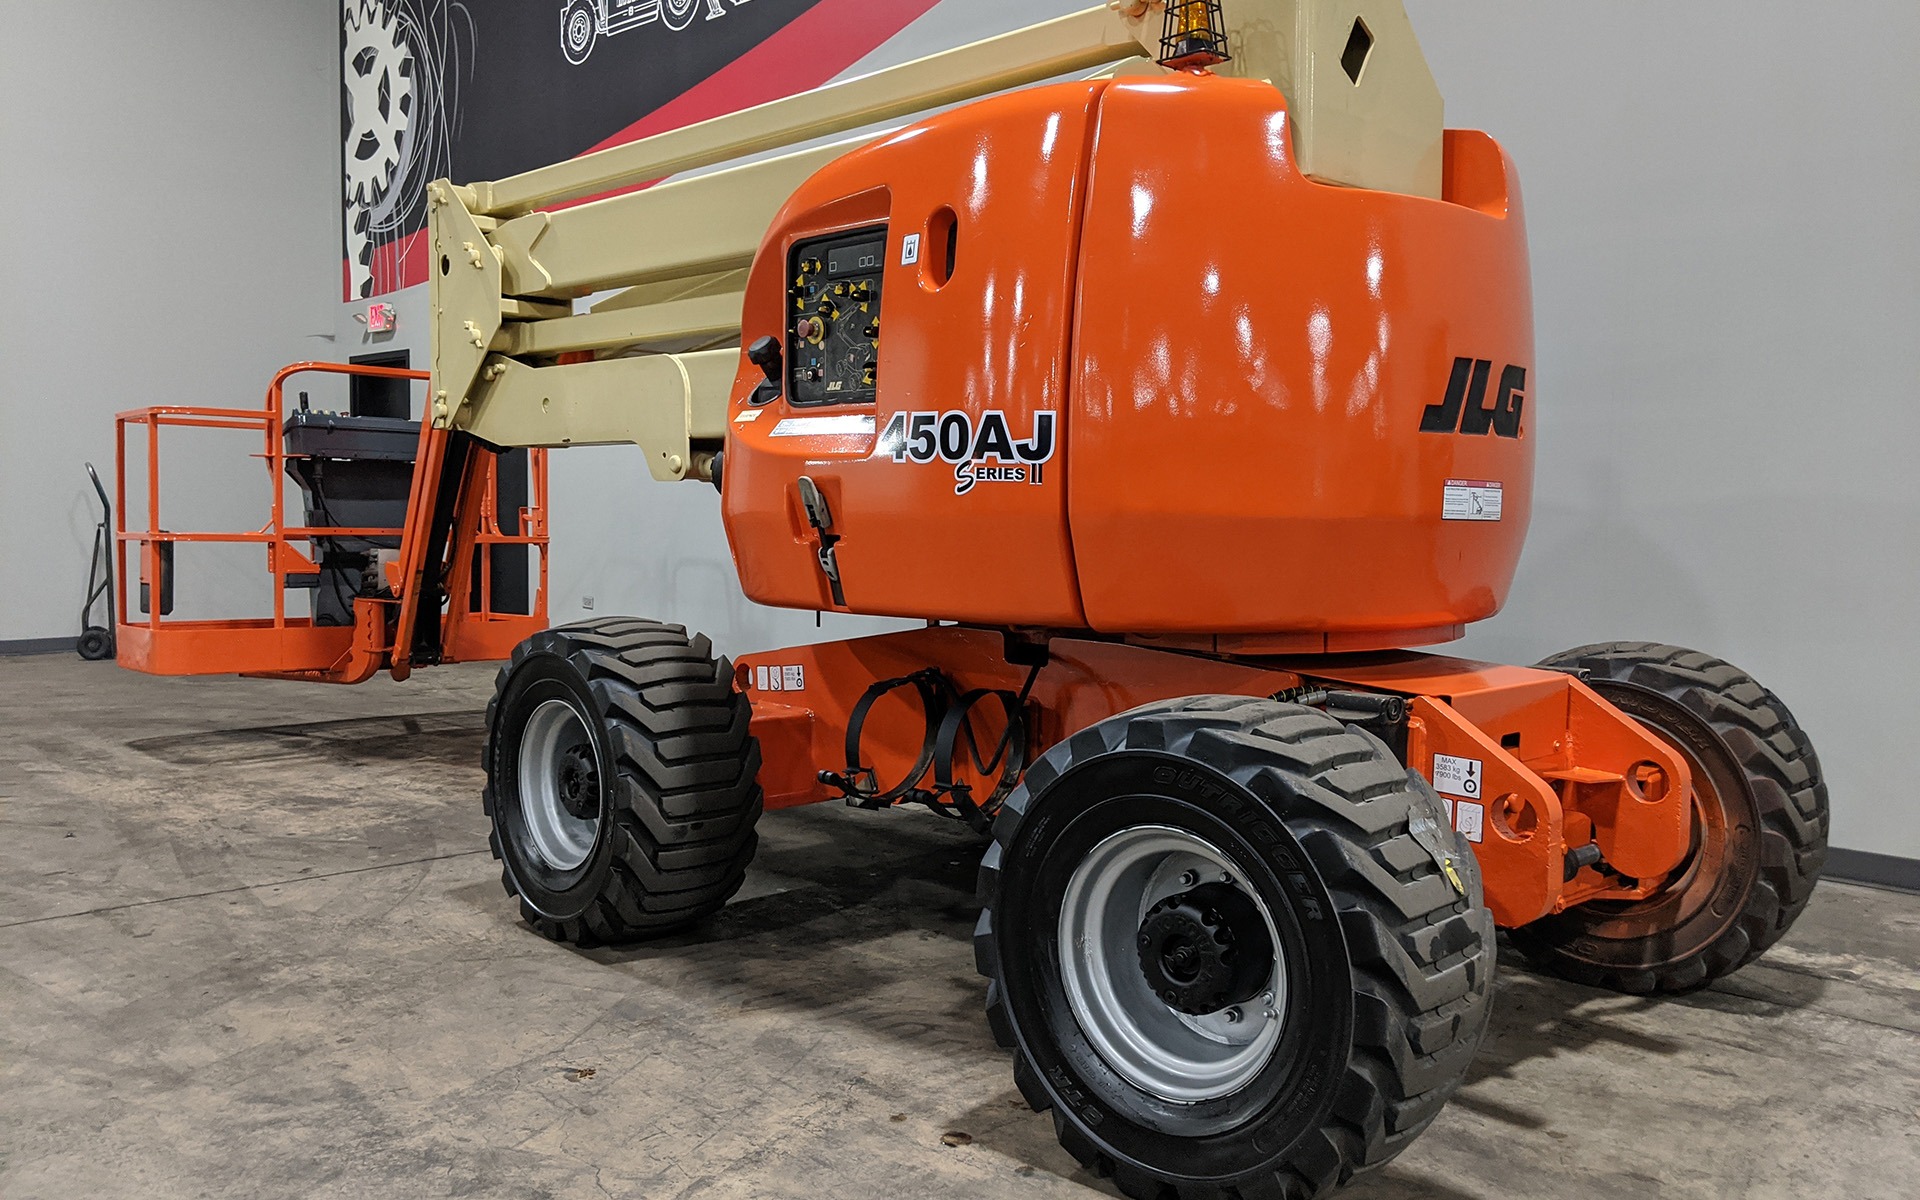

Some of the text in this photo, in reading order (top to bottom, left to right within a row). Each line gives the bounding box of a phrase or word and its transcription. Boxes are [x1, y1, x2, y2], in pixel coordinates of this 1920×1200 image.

[827, 381, 843, 391] JLG
[1419, 357, 1526, 439] JLG
[877, 411, 1057, 463] 450AJ
[1030, 462, 1044, 485] II
[1435, 763, 1461, 775] 3583 kg
[1441, 757, 1457, 765] MAX
[1435, 770, 1462, 782] 7900 lbs
[1152, 764, 1324, 921] OUTRIGGER
